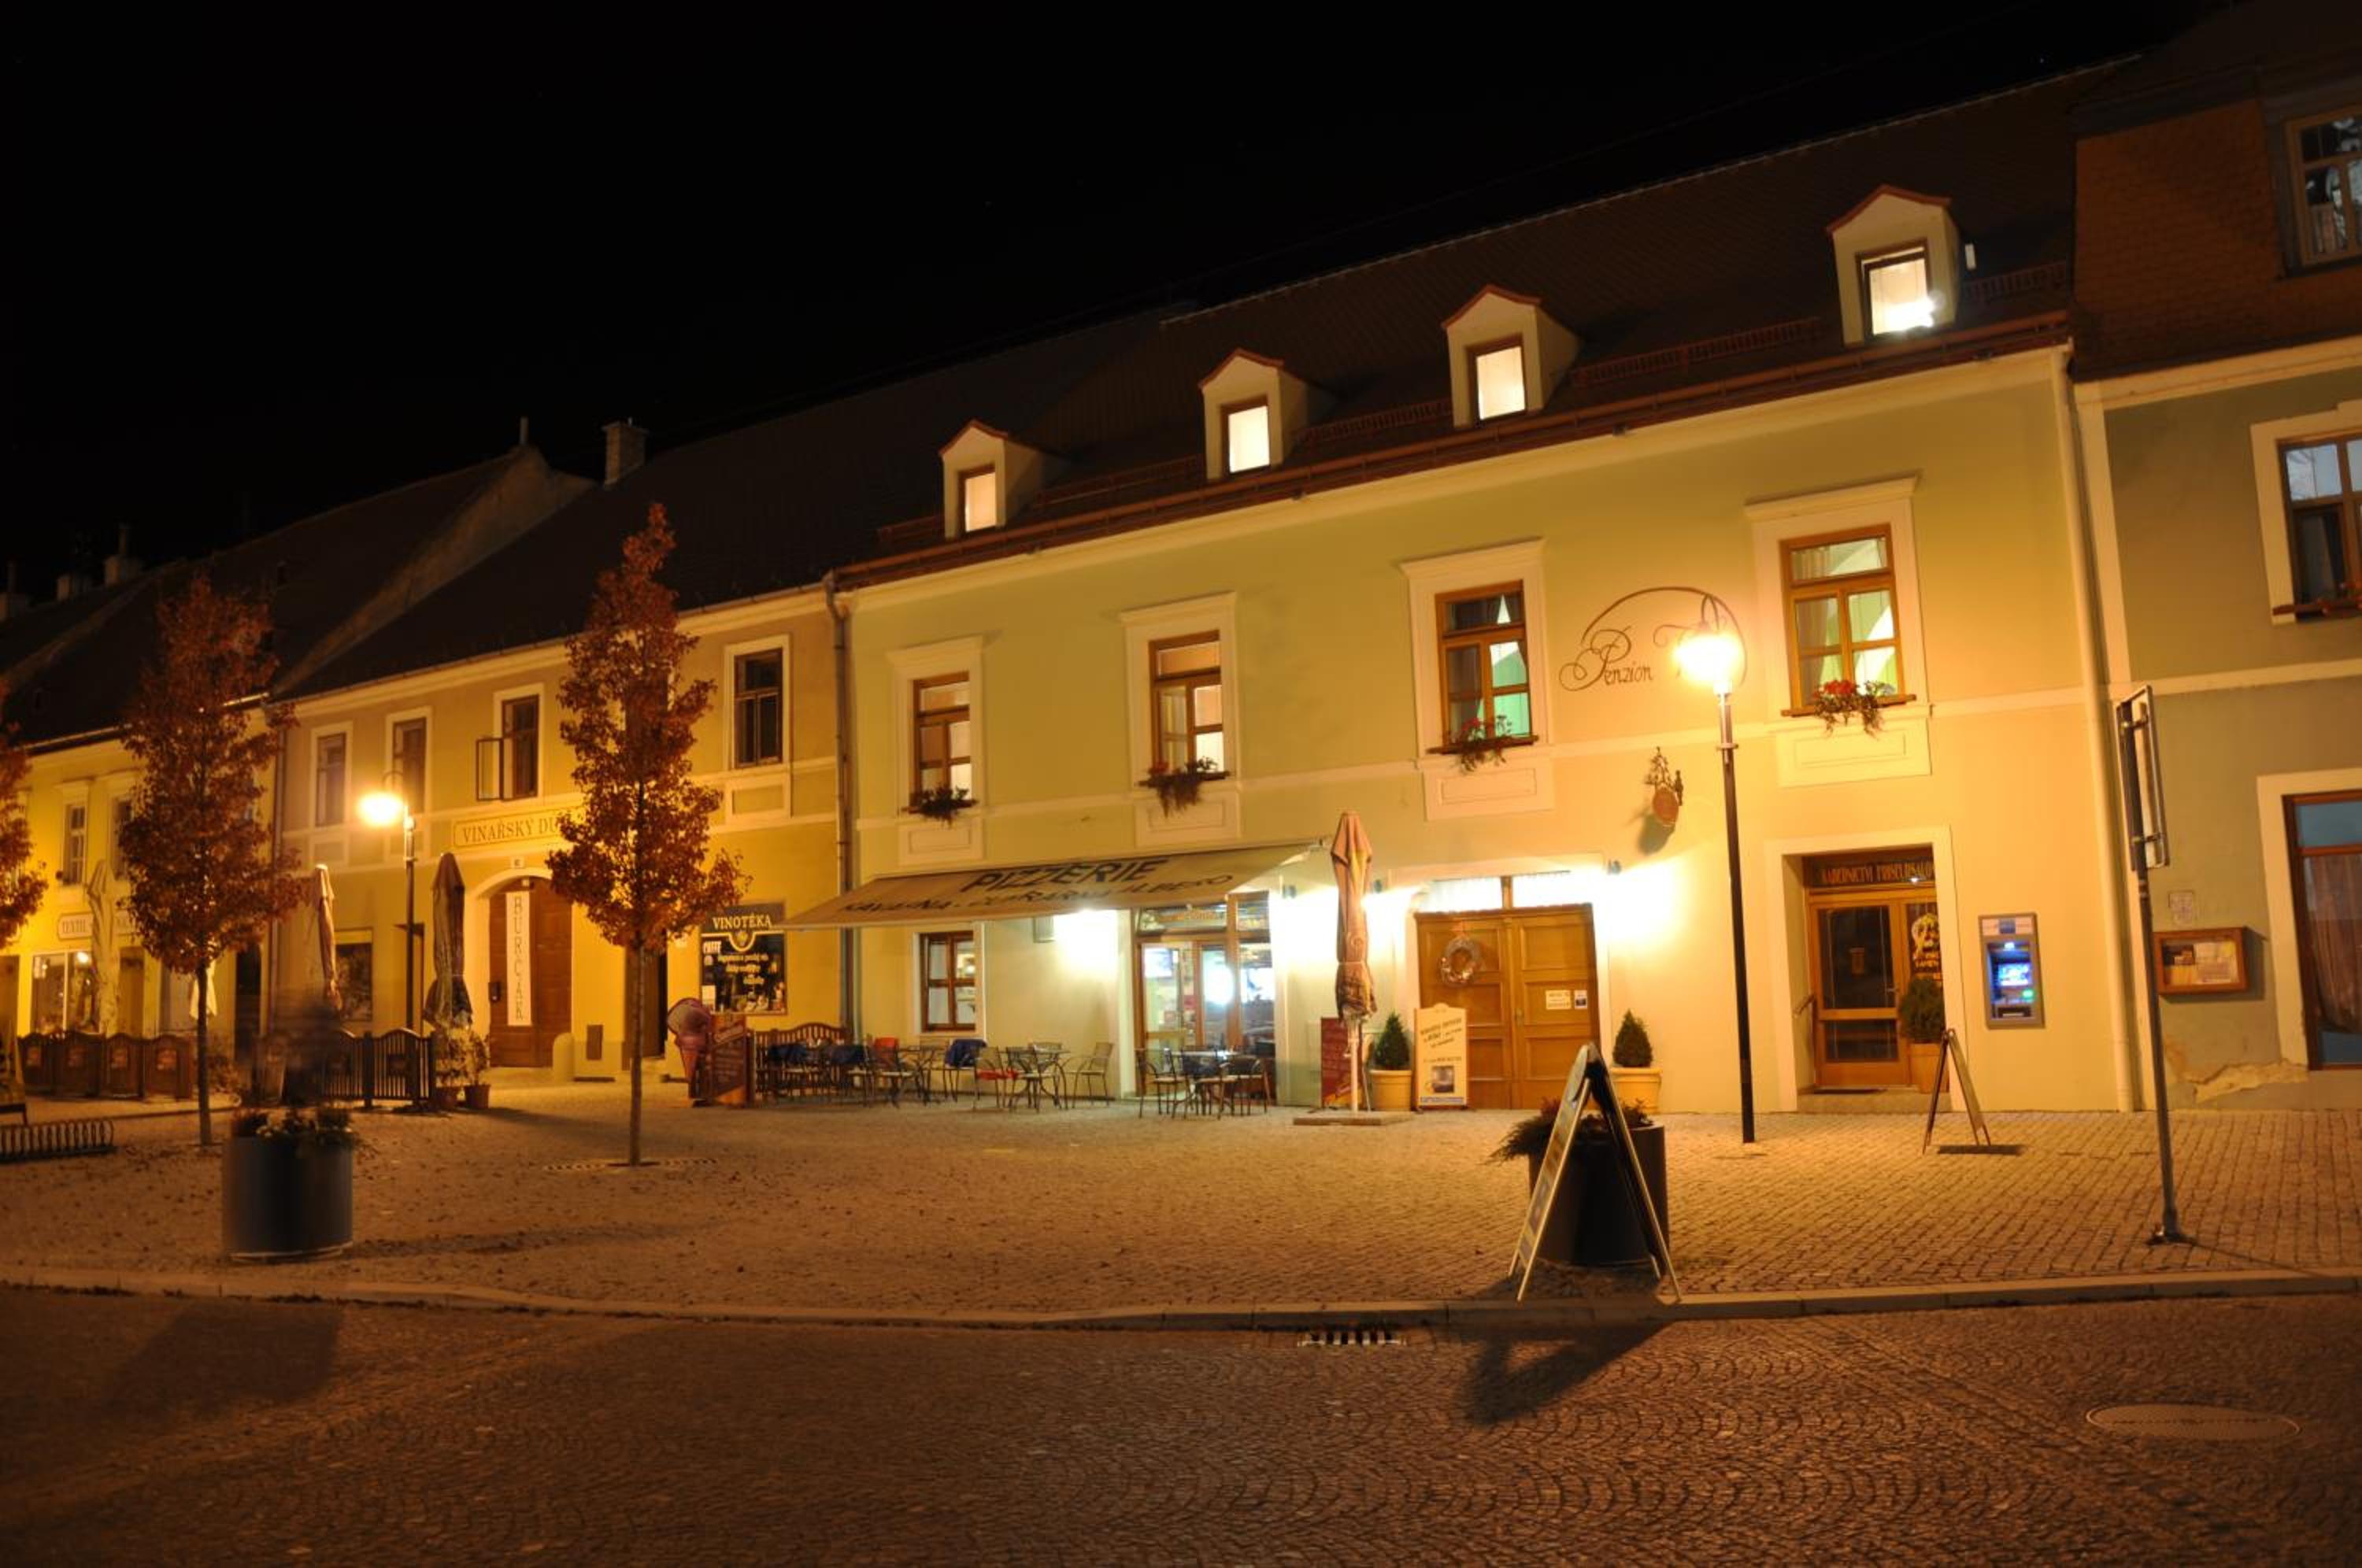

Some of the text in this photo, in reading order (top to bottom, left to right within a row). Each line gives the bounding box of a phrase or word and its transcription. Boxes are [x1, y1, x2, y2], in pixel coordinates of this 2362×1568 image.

[1559, 625, 1653, 691] Penzion
[959, 856, 1170, 893] PIZZERIE
[712, 912, 772, 930] VINOTÉKA
